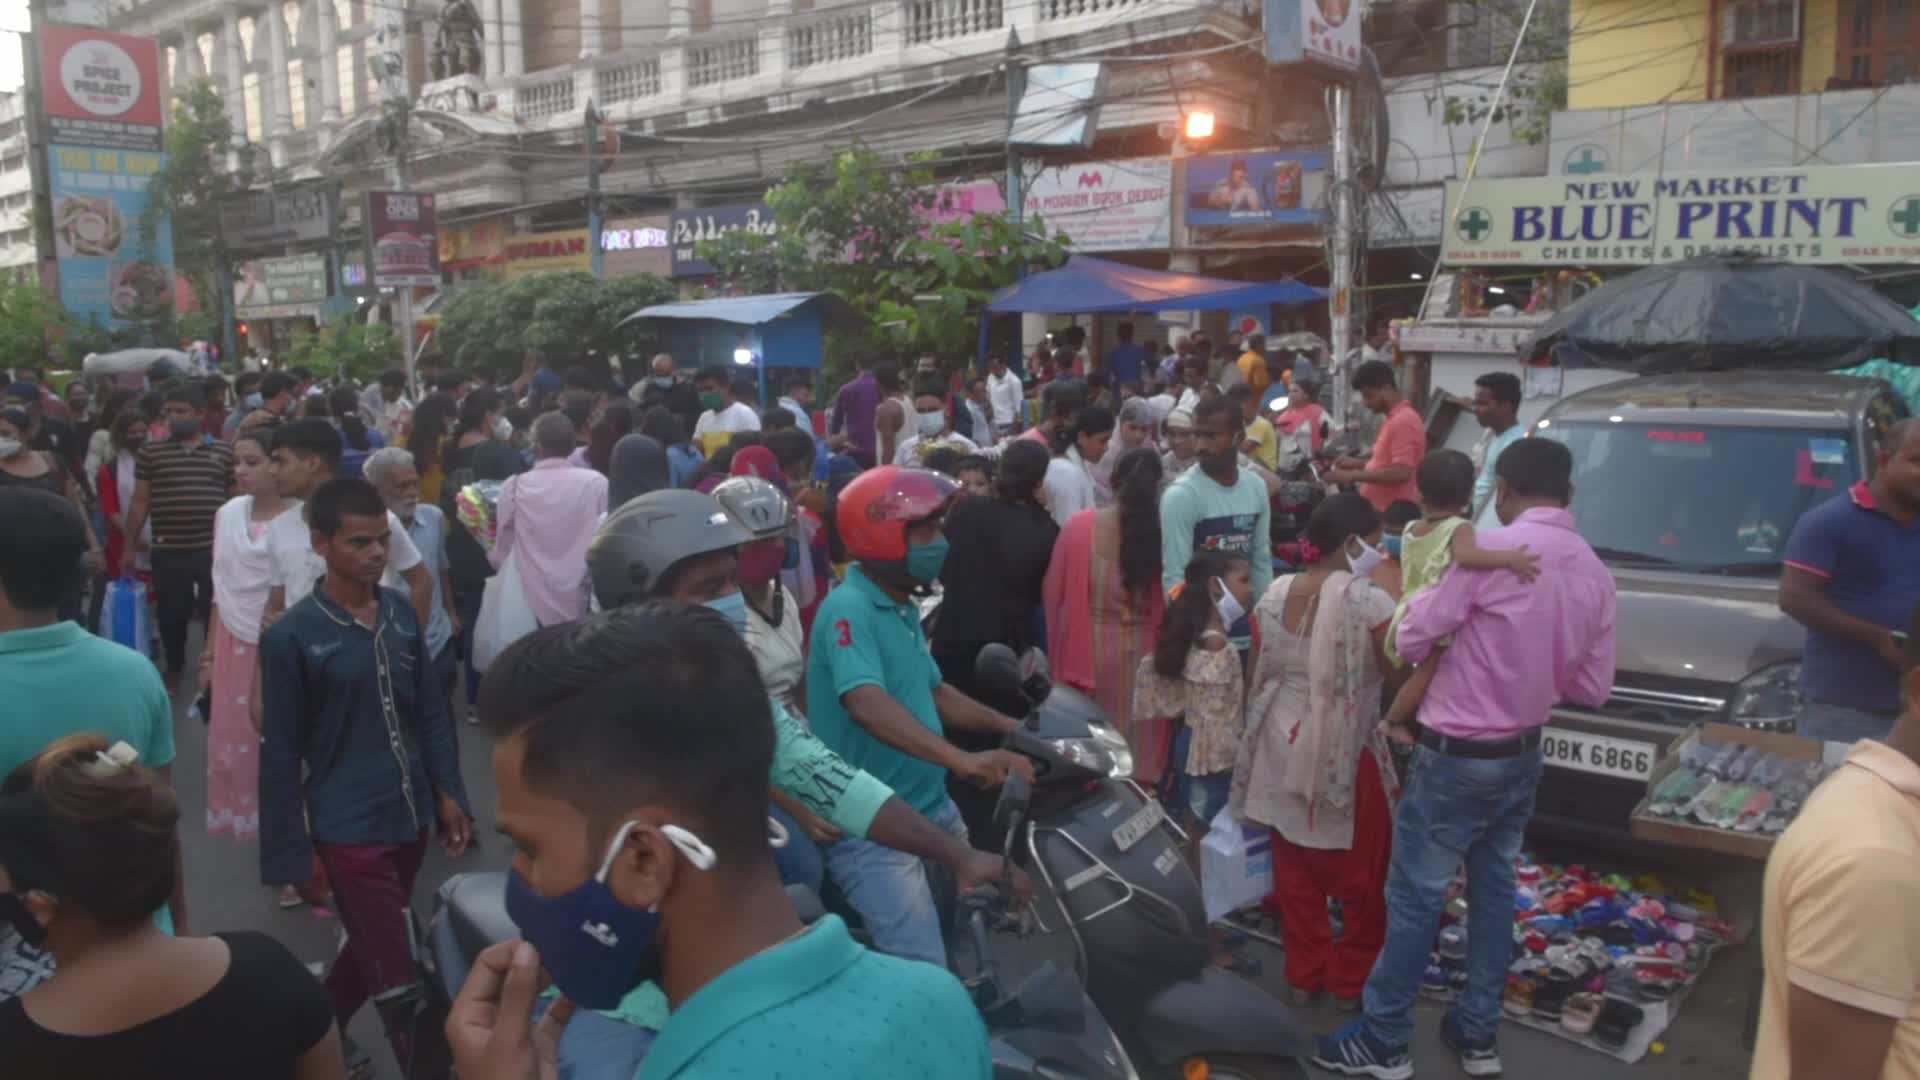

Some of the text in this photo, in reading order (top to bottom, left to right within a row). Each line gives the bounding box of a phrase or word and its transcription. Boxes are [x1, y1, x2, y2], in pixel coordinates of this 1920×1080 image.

[83, 65, 121, 80] SPICE
[74, 80, 131, 96] PROJECT
[1565, 175, 1807, 200] NEW MARKET
[1511, 197, 1868, 242] BLUE PRINT
[1541, 246, 1652, 260] CHEMISTS
[1660, 245, 1674, 259] &
[834, 619, 852, 648] 3
[1543, 736, 1649, 774] 08K 6866
